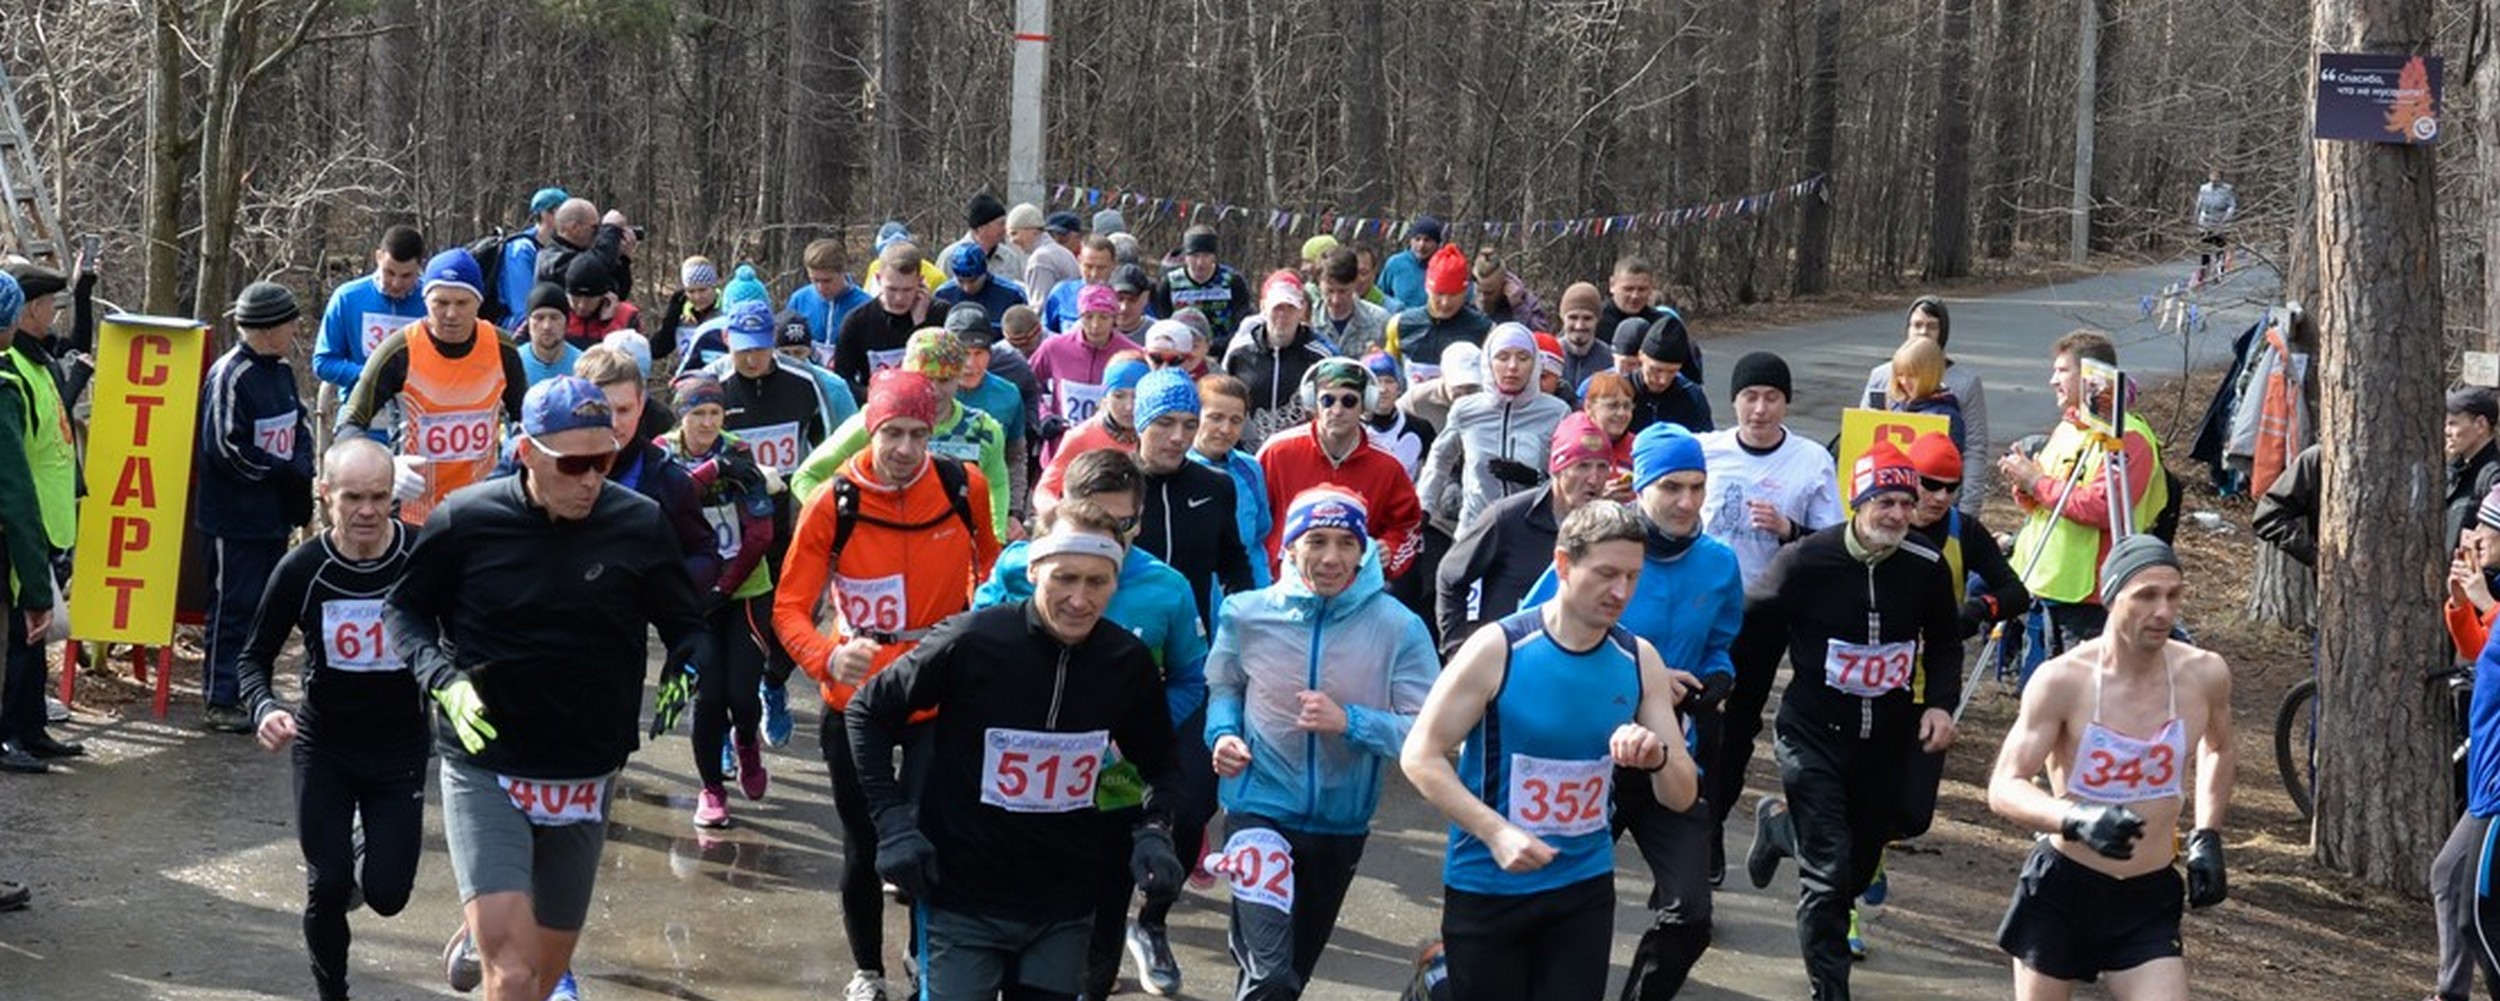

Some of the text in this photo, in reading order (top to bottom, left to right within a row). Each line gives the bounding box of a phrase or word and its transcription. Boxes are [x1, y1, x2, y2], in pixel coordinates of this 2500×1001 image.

[426, 422, 489, 455] 609
[757, 436, 795, 468] 03
[105, 334, 172, 630] СТАРТ
[335, 621, 394, 660] 61
[1836, 652, 1910, 688] 703
[997, 751, 1097, 799] 513
[2082, 743, 2174, 788] 343
[509, 779, 597, 814] 404
[1520, 775, 1604, 824] 352
